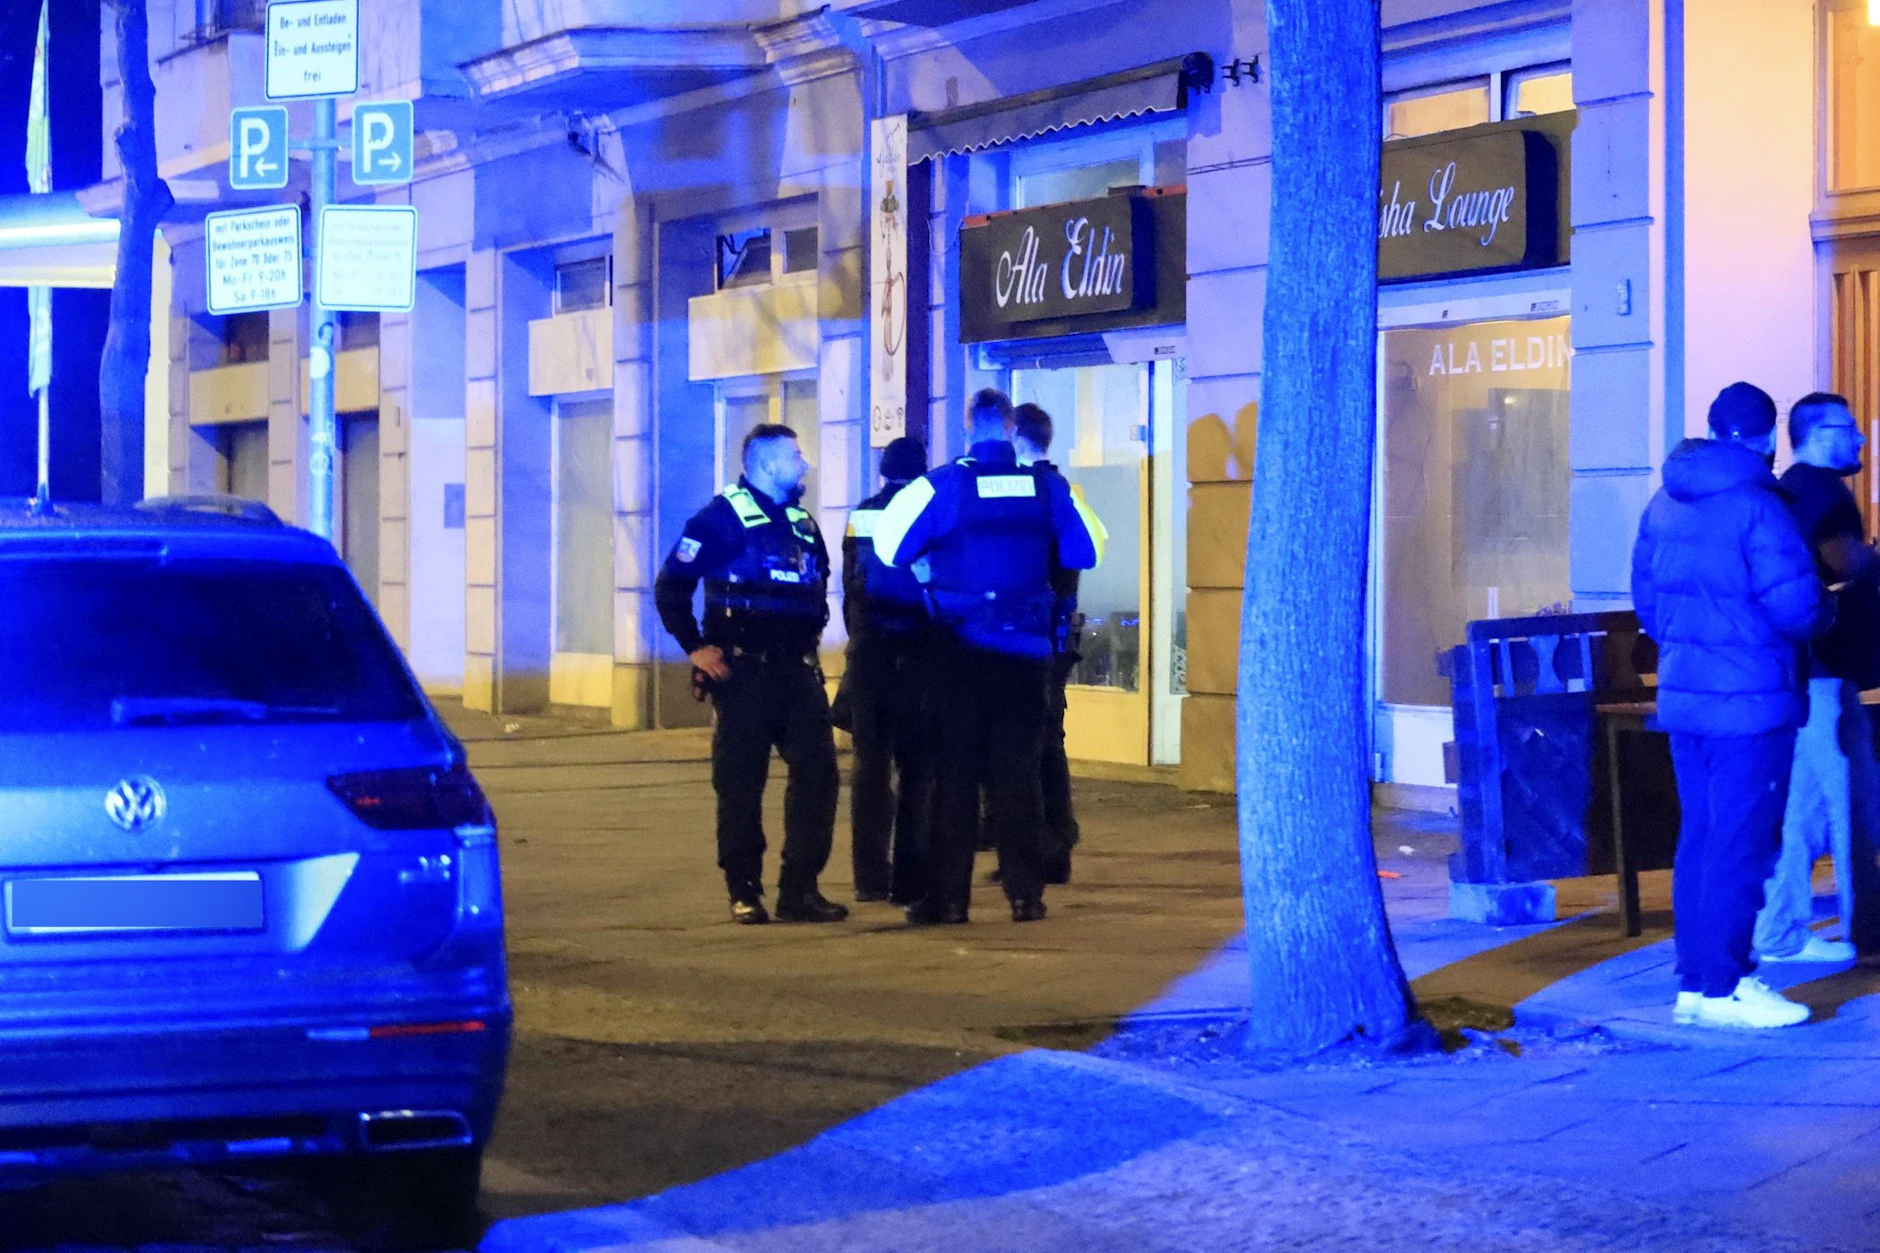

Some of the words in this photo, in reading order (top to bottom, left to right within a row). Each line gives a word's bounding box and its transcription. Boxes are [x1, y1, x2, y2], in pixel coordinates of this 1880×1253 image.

[297, 15, 311, 27] und
[314, 13, 347, 27] Entladen
[293, 43, 307, 56] und
[311, 41, 351, 55] Aussteigen
[304, 69, 321, 83] frei
[240, 118, 270, 178] P
[363, 112, 395, 173] P
[1424, 161, 1515, 247] Lounge
[230, 219, 271, 232] Parkschein
[274, 216, 290, 227] oder
[212, 235, 295, 253] Bewohnerparkausweis
[230, 256, 248, 269] Zone
[996, 225, 1048, 308] Ala
[1061, 217, 1125, 300] Eldin
[233, 290, 246, 303] Sa
[1428, 341, 1483, 376] ALA
[1490, 335, 1571, 372] ELDIN
